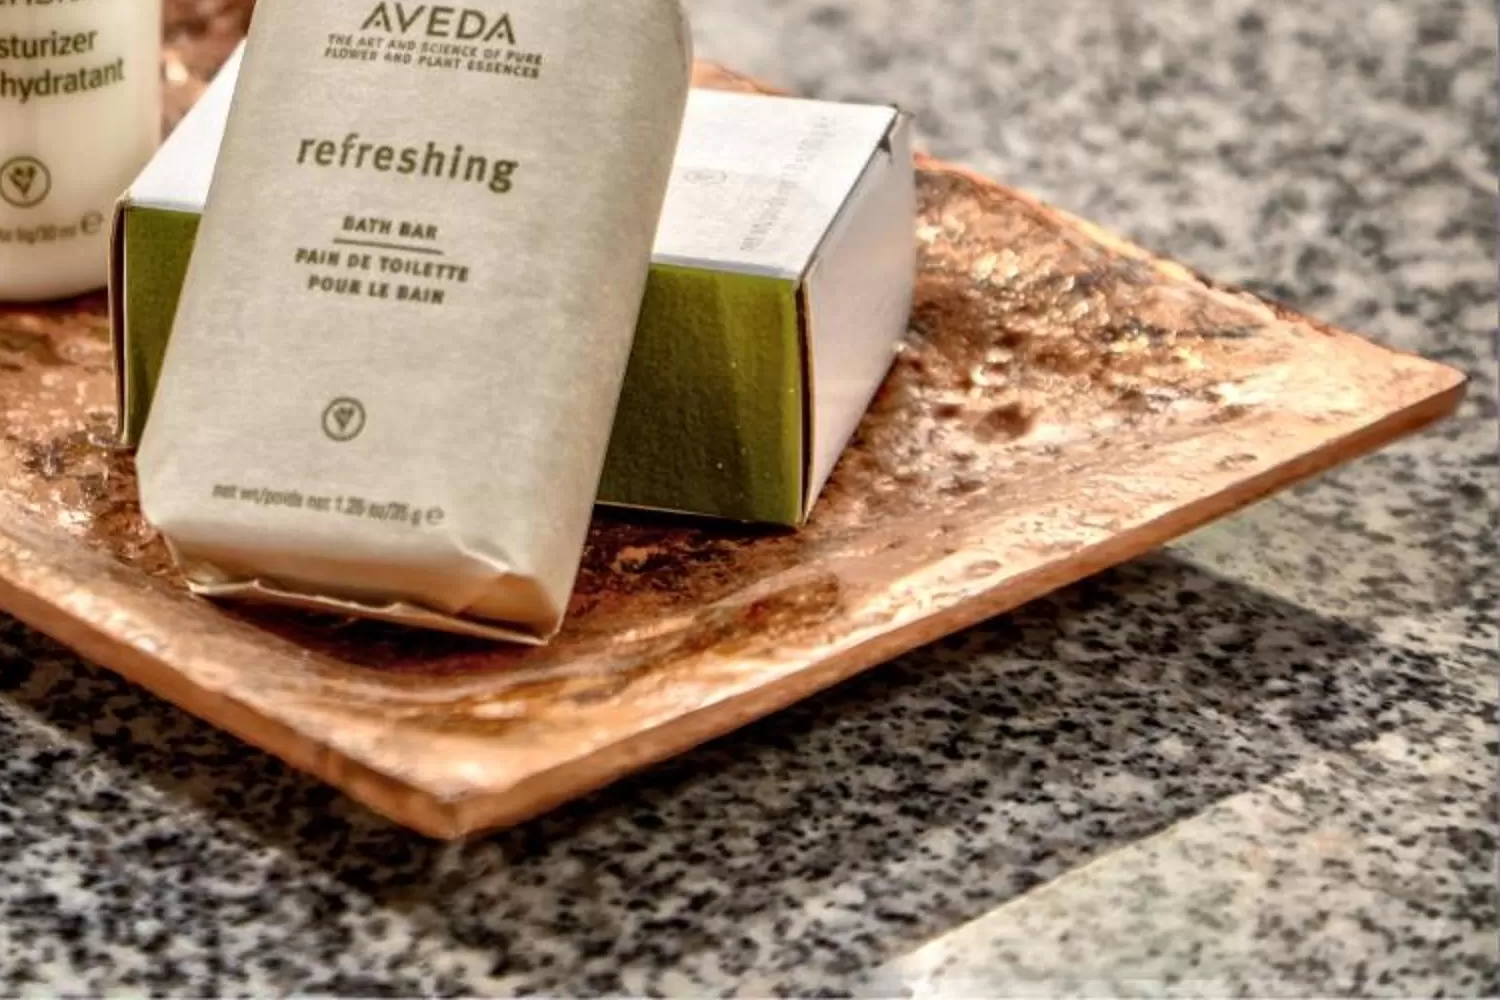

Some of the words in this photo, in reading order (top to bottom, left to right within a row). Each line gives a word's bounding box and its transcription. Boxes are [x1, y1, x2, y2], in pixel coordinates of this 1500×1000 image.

[360, 1, 516, 45] AVEDA
[324, 47, 377, 61] FLOWER
[384, 51, 412, 64] AND
[418, 55, 461, 69] PLANT
[467, 59, 540, 79] ESSENCES
[328, 34, 353, 46] THE
[357, 36, 384, 48] ART
[388, 39, 416, 51] AND
[421, 42, 478, 57] SCIENCE
[483, 48, 500, 59] OF
[506, 50, 542, 66] PURE
[0, 57, 125, 104] hydratant
[296, 132, 519, 194] refreshing
[341, 216, 392, 236] BATH
[398, 221, 438, 240] BAR
[295, 248, 340, 267] PAIN
[347, 253, 371, 271] DE
[379, 256, 470, 283] TOILETTE
[307, 275, 360, 296] POUR
[368, 282, 389, 299] LE
[396, 285, 445, 306] BAIN
